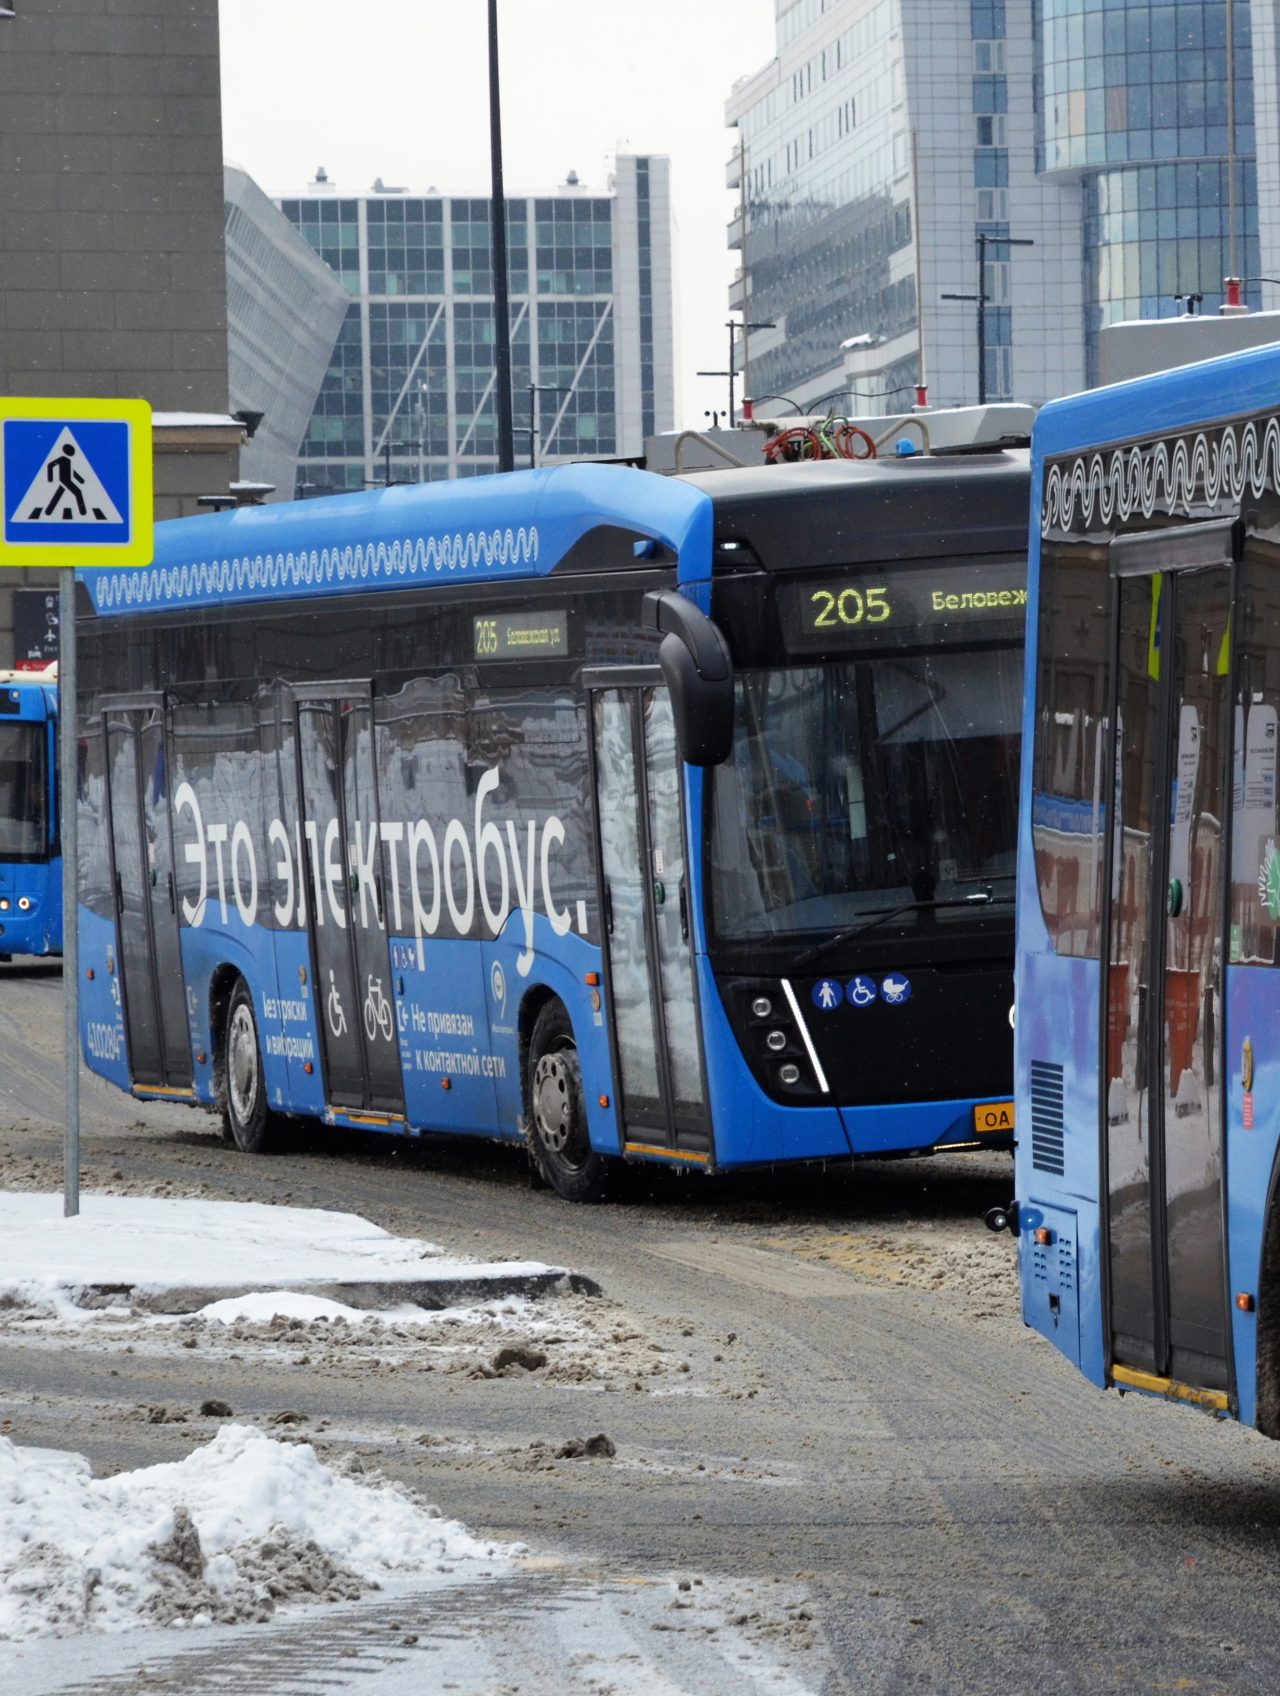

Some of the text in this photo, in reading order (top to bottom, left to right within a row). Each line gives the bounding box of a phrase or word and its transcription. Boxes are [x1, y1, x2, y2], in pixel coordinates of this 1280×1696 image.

[810, 588, 1027, 627] 205 Беловеж
[475, 620, 497, 654] 205
[174, 765, 588, 978] Это электробус.
[410, 1003, 475, 1041] Не привязан
[415, 1049, 423, 1071] к
[423, 1047, 481, 1077] контактной
[481, 1055, 507, 1079] сети
